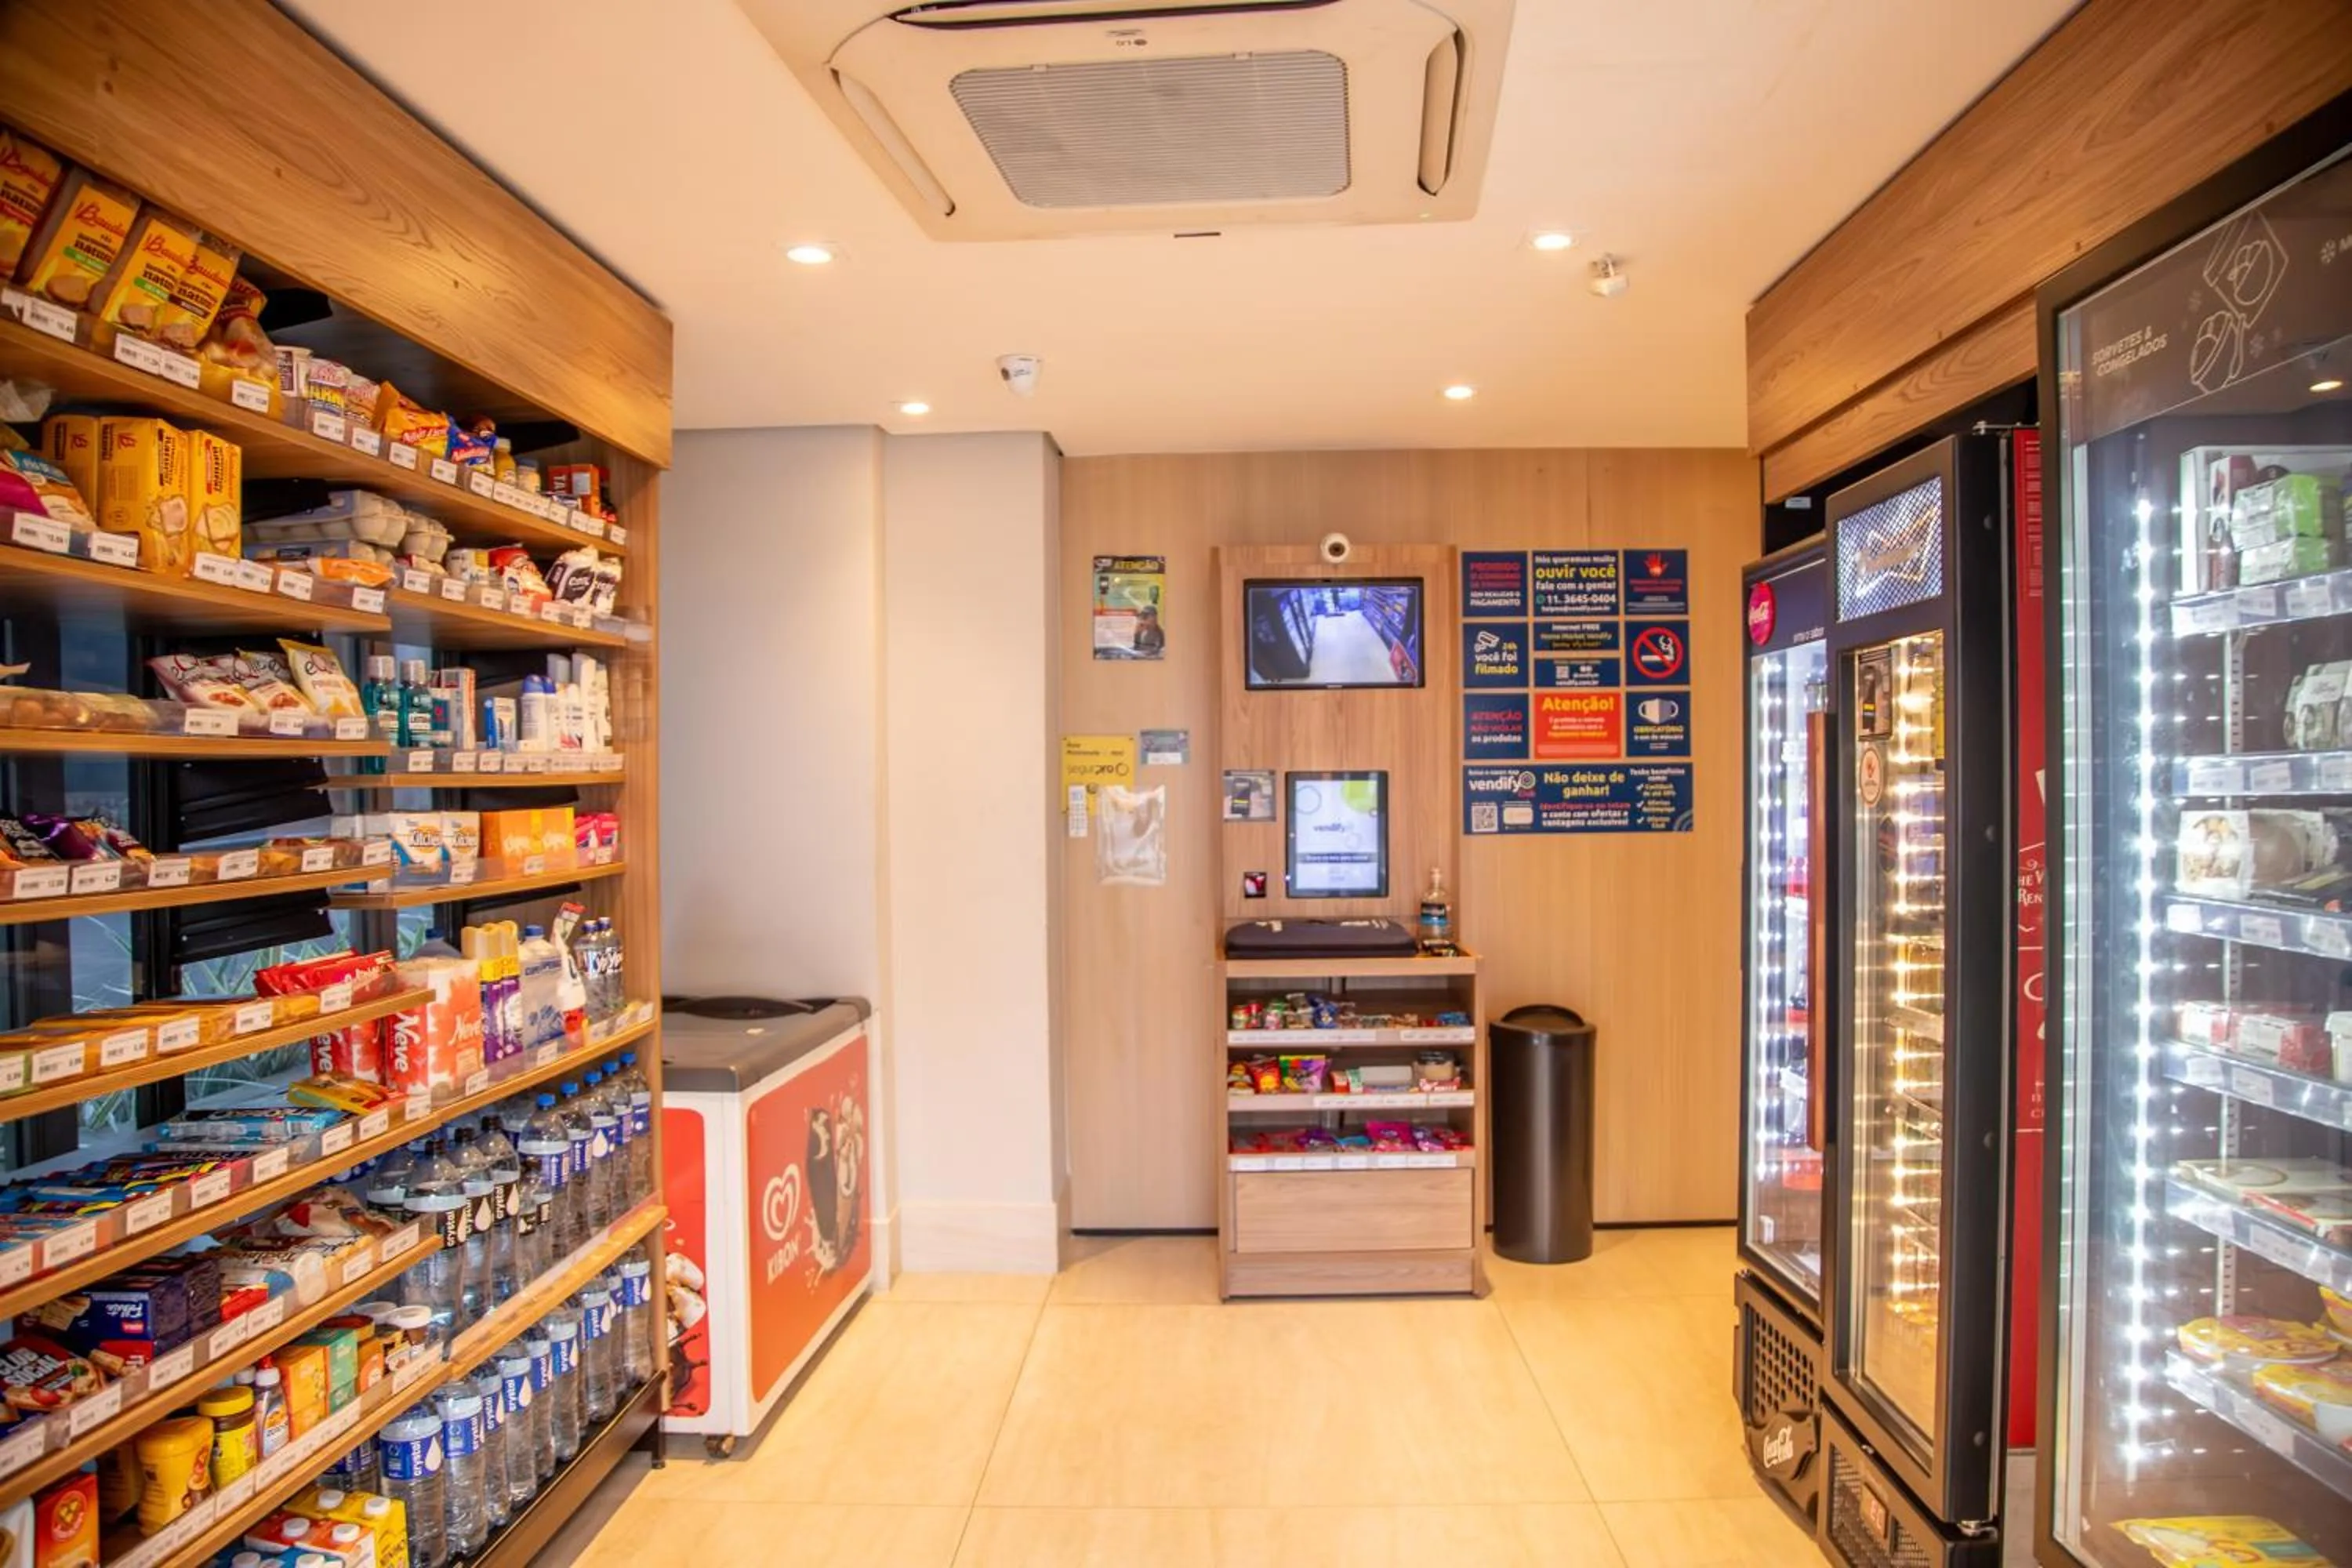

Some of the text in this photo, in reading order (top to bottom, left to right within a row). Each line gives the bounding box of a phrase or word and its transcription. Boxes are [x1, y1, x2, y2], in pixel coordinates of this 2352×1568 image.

[2096, 333, 2169, 376] CONGELADOS
[1536, 564, 1616, 578] ouvir você
[1475, 652, 1517, 662] você foi
[1475, 662, 1519, 675] filmado
[1541, 695, 1614, 714] Atenção!
[1468, 775, 1521, 793] vendify
[1544, 771, 1625, 783] Não deixe de
[1563, 784, 1610, 799] ganhar!
[447, 1210, 456, 1247] crystal
[767, 1232, 801, 1286] KIBON
[470, 1414, 479, 1450] crystal
[411, 1439, 423, 1476] crystal
